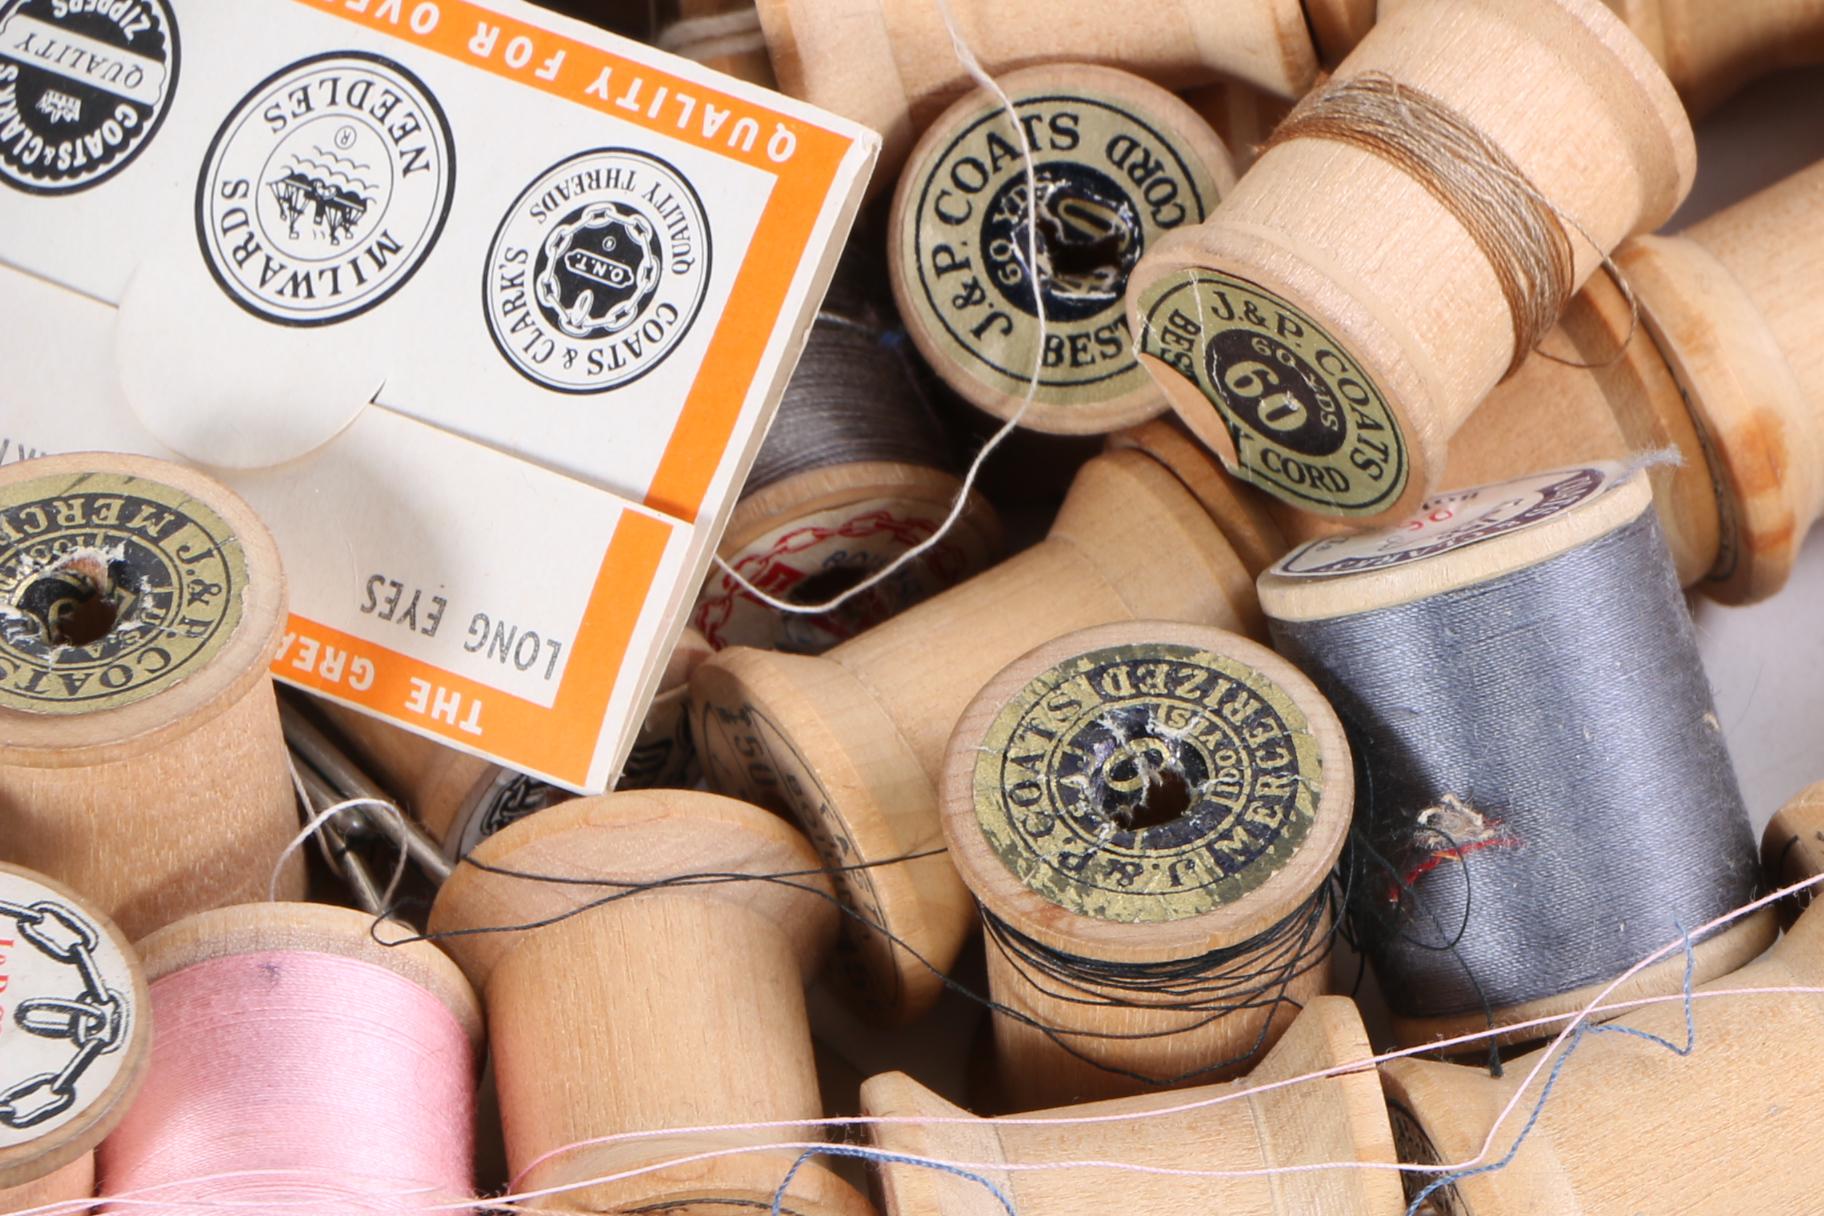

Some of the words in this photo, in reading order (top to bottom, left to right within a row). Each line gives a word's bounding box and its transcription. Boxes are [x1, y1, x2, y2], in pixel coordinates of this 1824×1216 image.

[14, 32, 144, 89] QUALITY
[467, 22, 566, 80] FOR
[263, 76, 431, 179] NEEDLES
[585, 76, 798, 163] QUALITY
[528, 167, 637, 226] THREADS
[933, 111, 1081, 226] COATS
[1105, 133, 1188, 230] CORD
[220, 178, 404, 299] MILWARDS
[641, 179, 695, 276] QUALITY
[501, 247, 557, 365] CLARK'S
[585, 302, 680, 376] COATS
[563, 347, 579, 368] &
[1160, 309, 1202, 380] BES
[1251, 337, 1298, 367] 60
[1223, 360, 1309, 432] 60
[1316, 349, 1391, 482] COATS
[1260, 447, 1351, 494] CORD
[360, 573, 448, 638] EYES
[463, 612, 562, 681] LONG
[404, 676, 484, 736] THE
[1007, 691, 1083, 840] COATS
[1100, 662, 1299, 867] MERCERIZED
